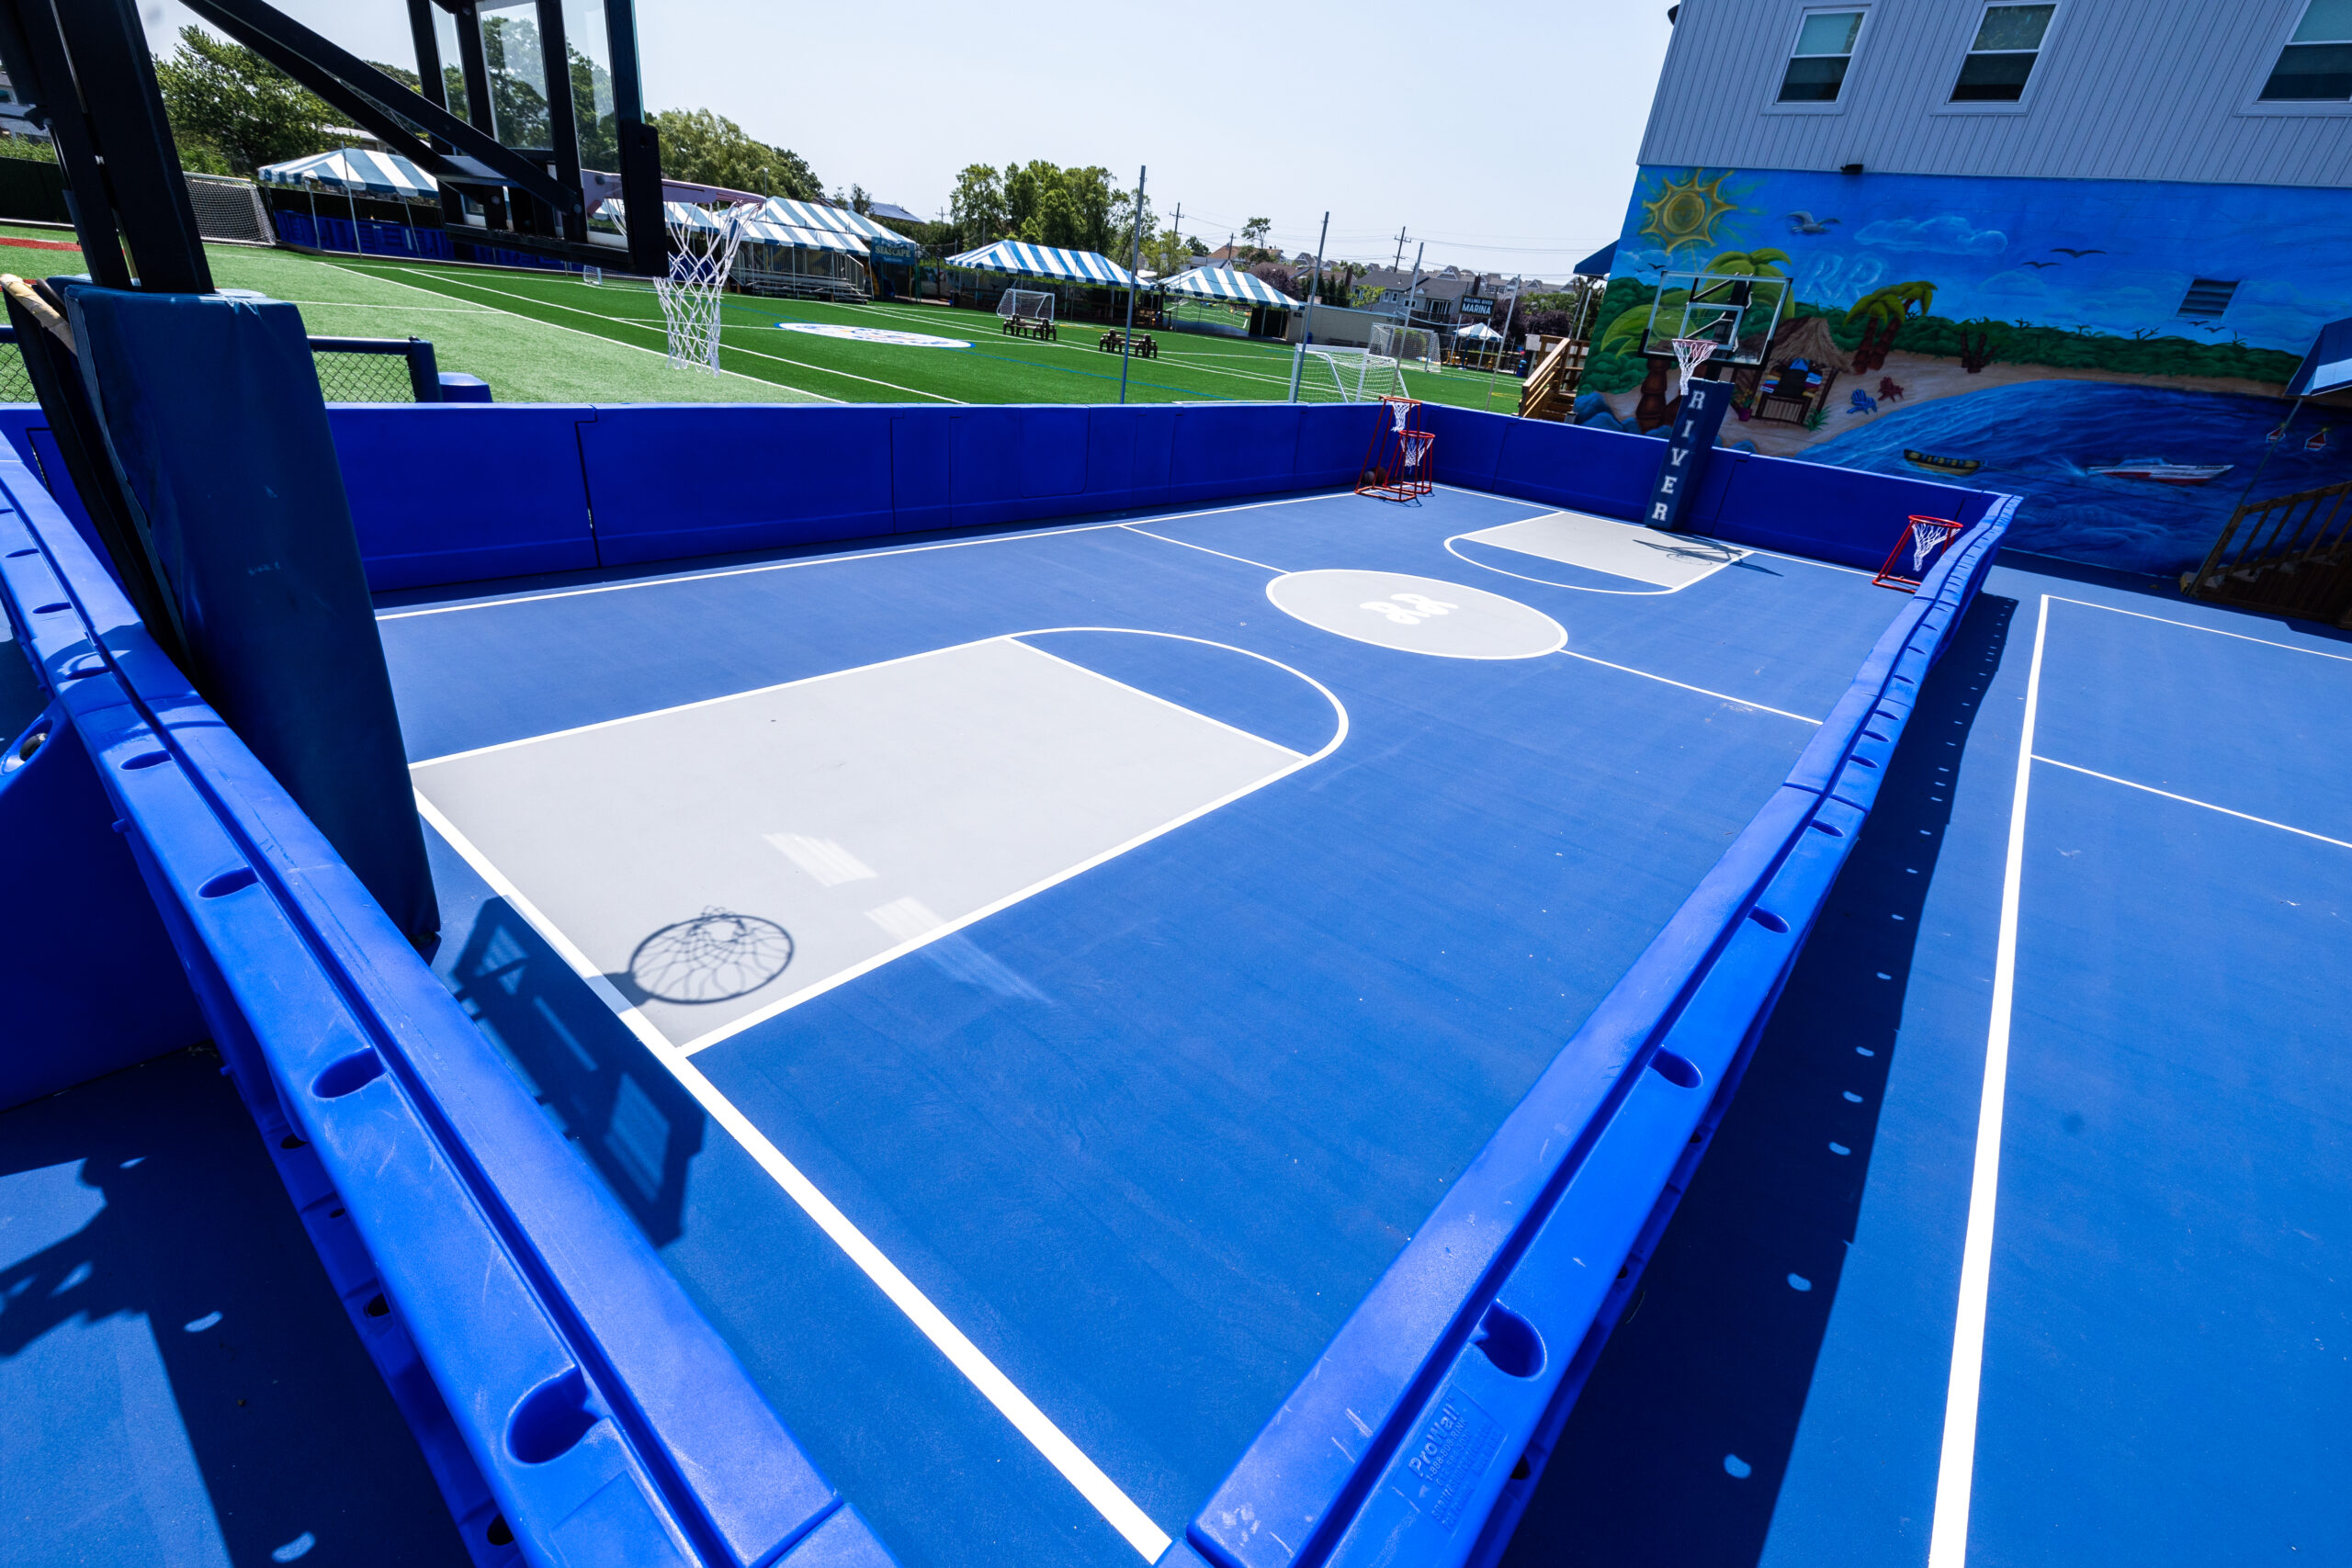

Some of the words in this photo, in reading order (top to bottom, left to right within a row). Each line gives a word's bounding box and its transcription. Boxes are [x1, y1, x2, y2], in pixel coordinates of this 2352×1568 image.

[875, 245, 911, 257] SEASCAPE
[1800, 250, 1887, 299] RR
[1462, 303, 1491, 315] MARINA
[1651, 389, 1706, 521] RIVER
